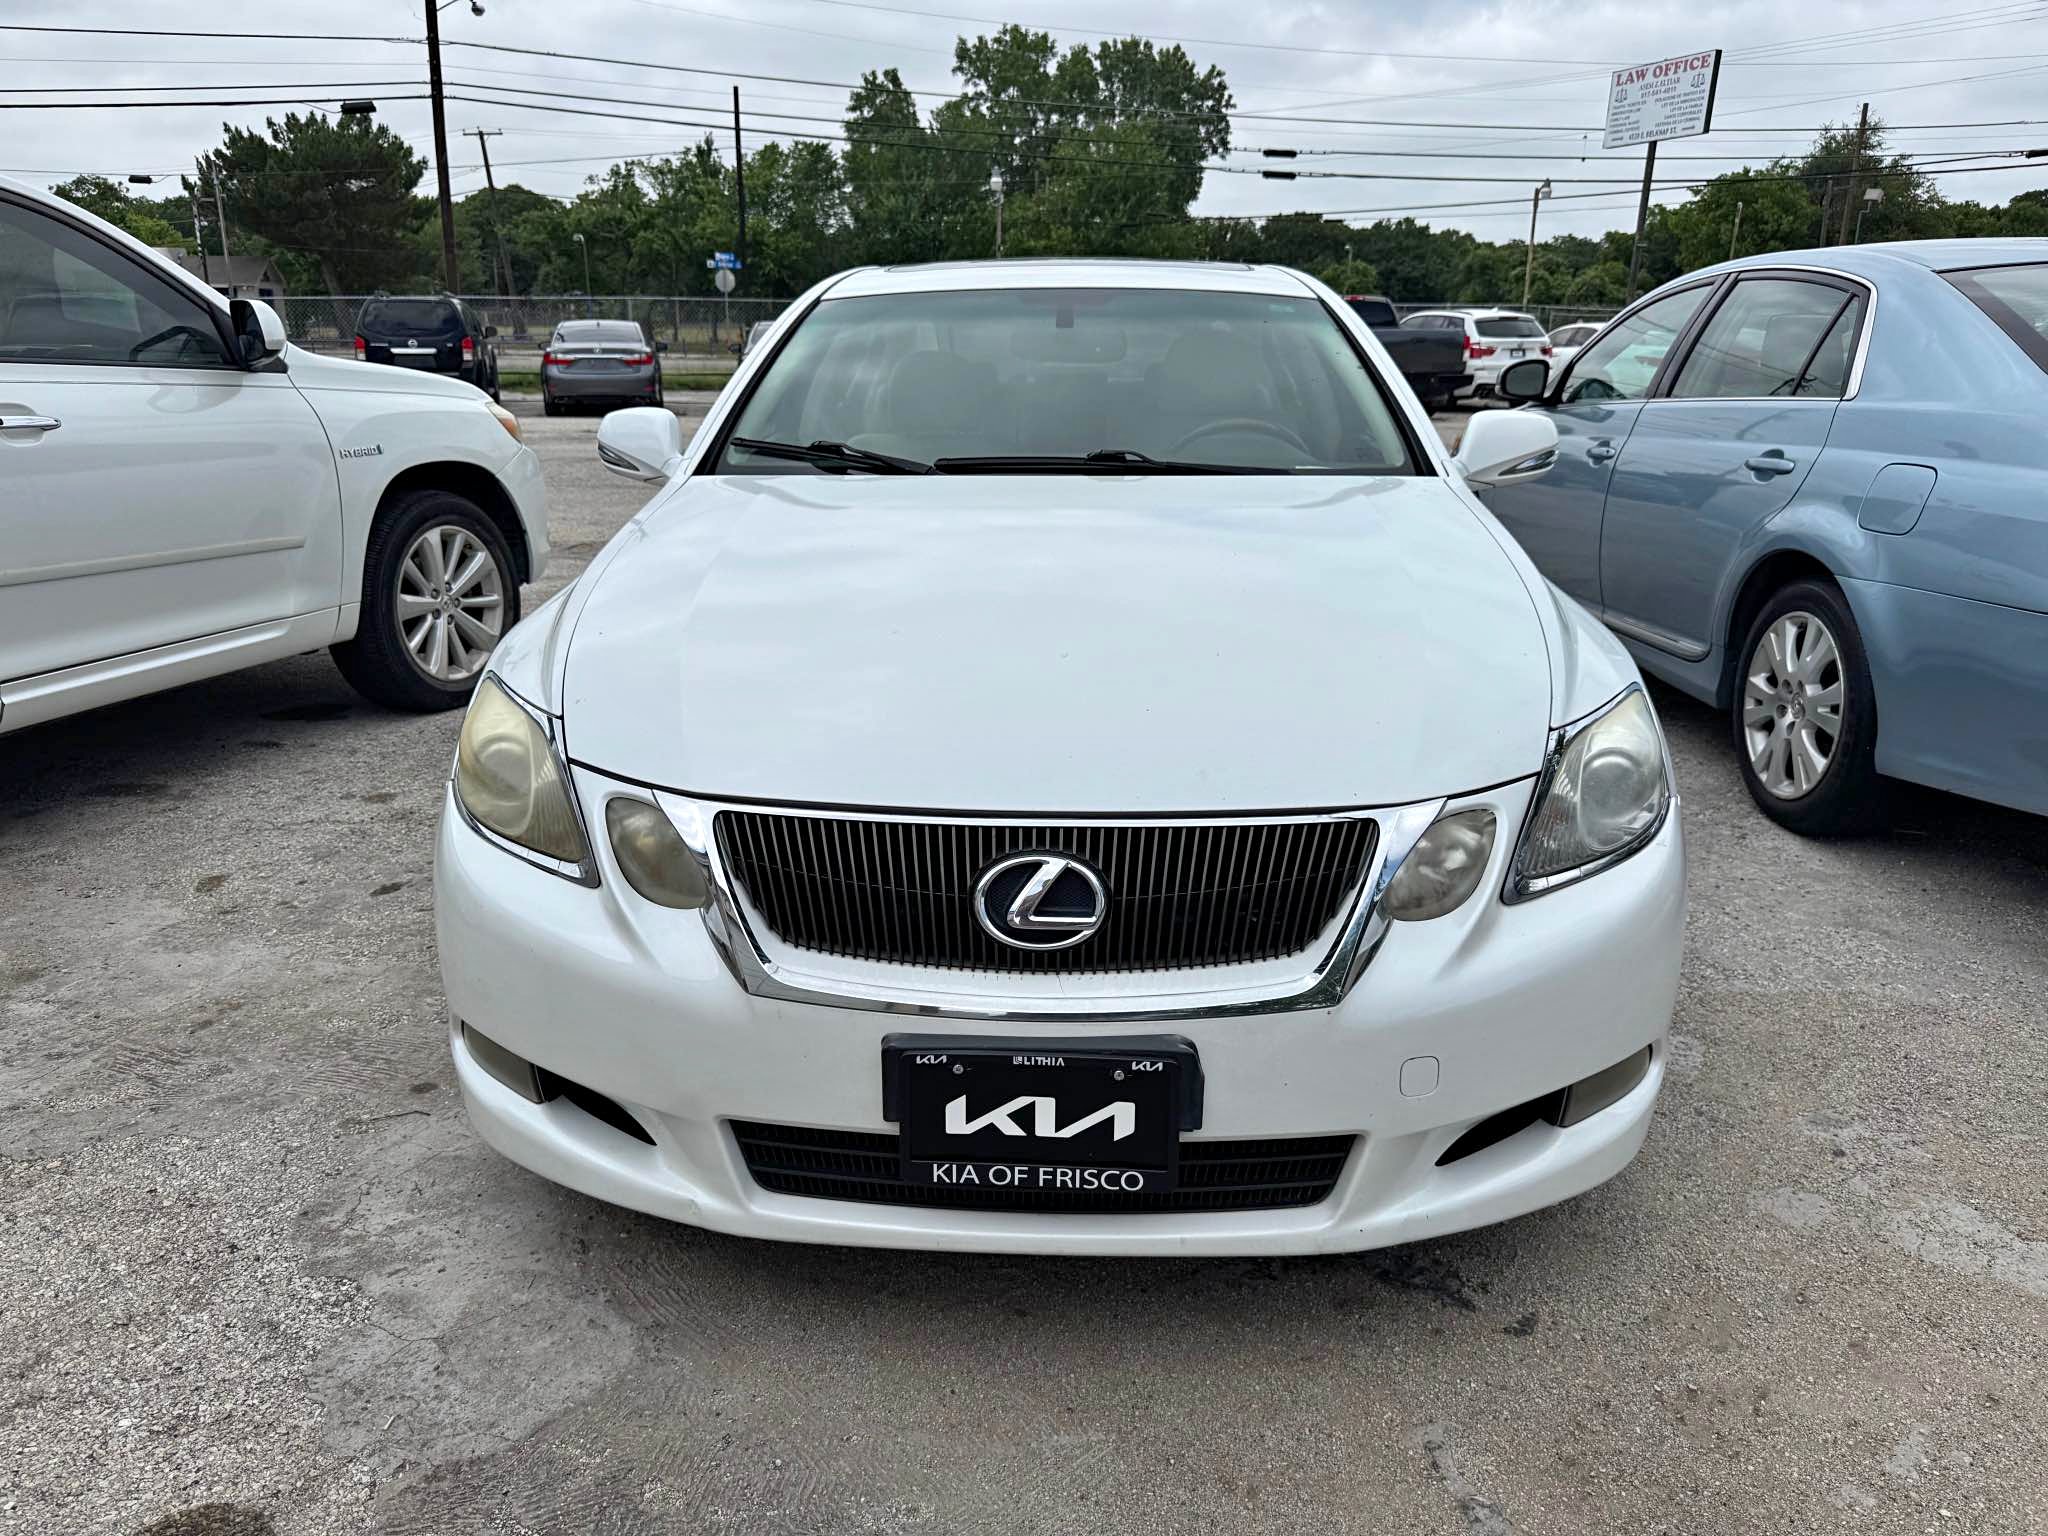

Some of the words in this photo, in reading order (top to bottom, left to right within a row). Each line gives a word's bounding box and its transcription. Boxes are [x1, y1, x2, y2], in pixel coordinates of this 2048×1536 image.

[1616, 69, 1648, 86] LAW
[1652, 54, 1711, 79] OFFICE
[339, 445, 379, 459] HYBRID
[1024, 1056, 1065, 1066] LITHIA
[933, 1164, 979, 1184] KIA
[989, 1166, 1028, 1185] OF
[1039, 1168, 1144, 1191] FRISCO
